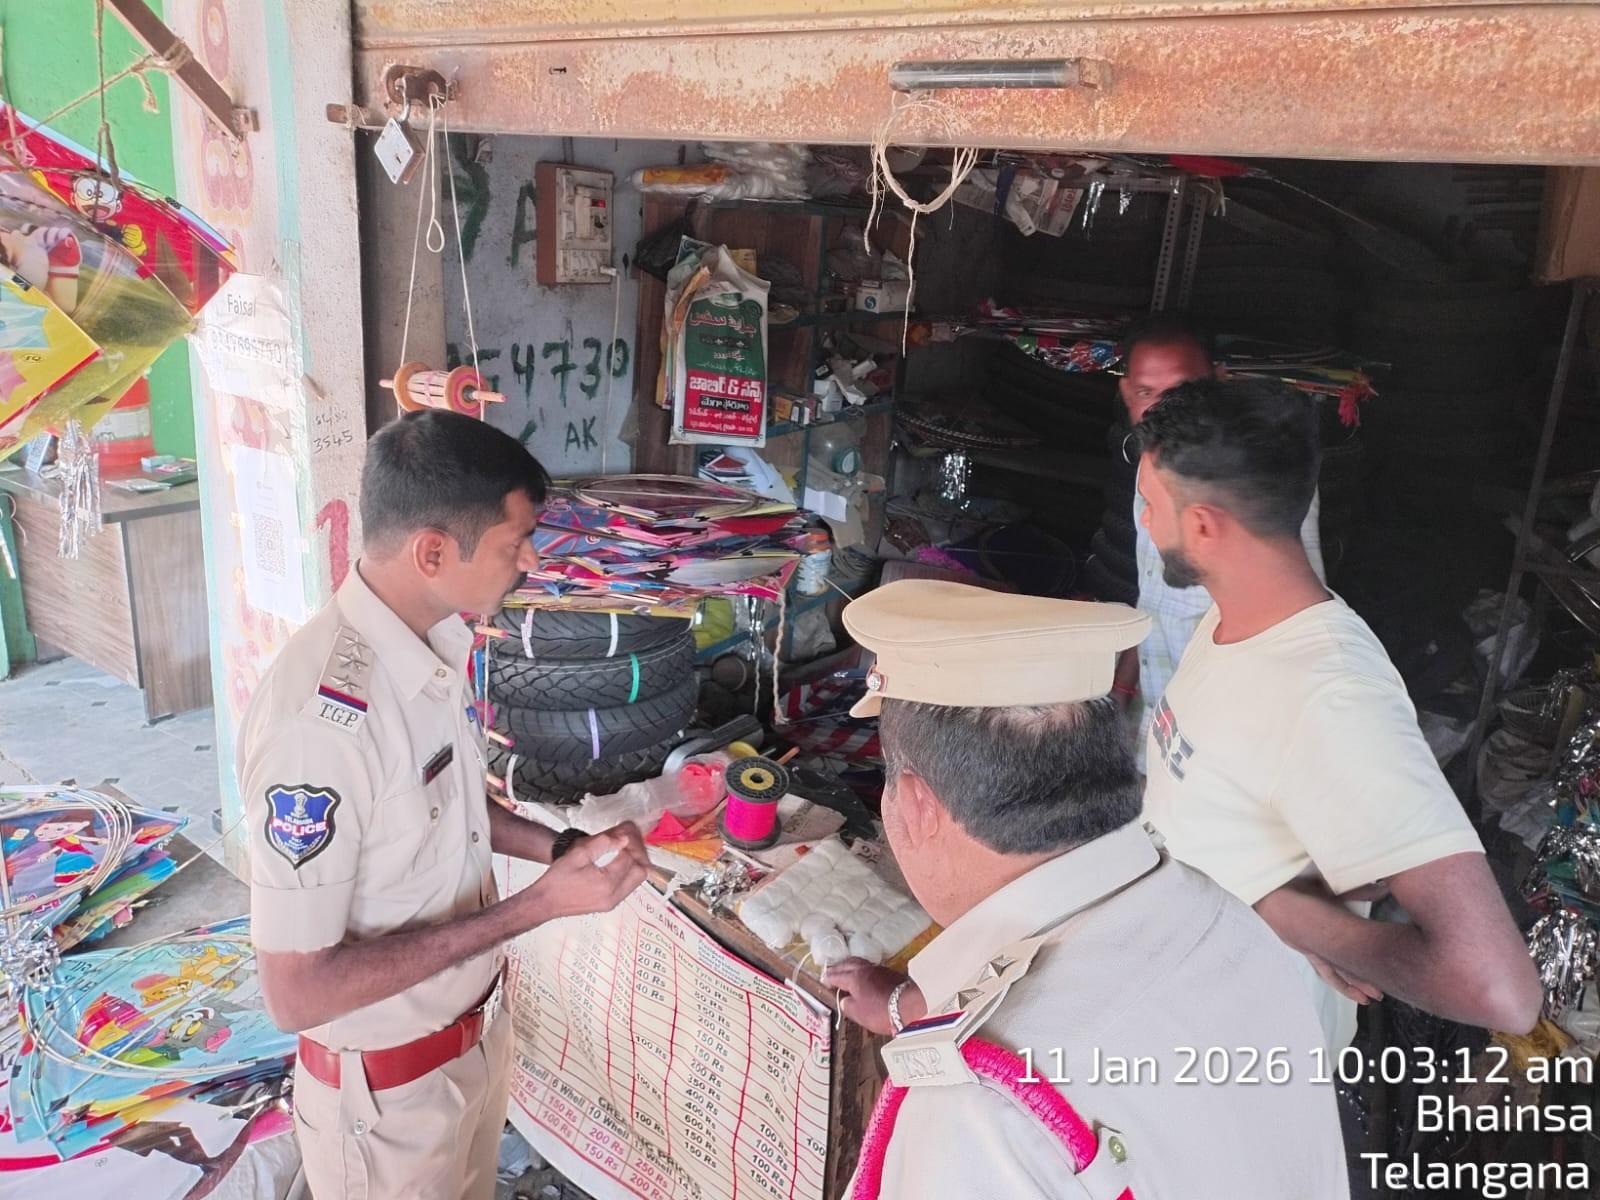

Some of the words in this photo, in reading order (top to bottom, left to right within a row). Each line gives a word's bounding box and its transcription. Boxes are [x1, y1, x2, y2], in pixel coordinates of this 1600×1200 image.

[227, 294, 256, 318] Faisal
[565, 416, 598, 452] AK
[272, 818, 327, 837] POLICE
[639, 941, 652, 952] 20
[654, 947, 667, 960] Rs
[638, 954, 650, 966] 20
[653, 962, 667, 974] Rs
[637, 968, 649, 980] 40
[652, 975, 666, 988] Rs
[636, 983, 648, 994] 40
[651, 990, 665, 1002] Rs
[695, 979, 711, 993] 100
[714, 991, 728, 1003] Rs
[697, 1004, 714, 1018] 150
[718, 1015, 730, 1028] Rs
[710, 1000, 724, 1012] Rs
[760, 1003, 773, 1015] Air
[698, 1015, 716, 1031] 200
[718, 1028, 730, 1041] Rs
[636, 1036, 653, 1050] 100
[655, 1047, 667, 1060] Rs
[696, 1030, 714, 1046] 150
[715, 1043, 729, 1057] Rs
[767, 1037, 779, 1050] 30
[782, 1049, 796, 1061] Rs
[522, 1056, 549, 1080] Whell
[694, 1045, 710, 1062] 150
[712, 1058, 725, 1072] Rs
[767, 1051, 780, 1064] 50
[690, 1059, 707, 1077] 200
[709, 1074, 722, 1087] Rs
[767, 1065, 780, 1078] 50
[525, 1080, 537, 1093] Rs
[552, 1079, 558, 1088] 6
[560, 1084, 586, 1107] Whell
[652, 1088, 662, 1100] Rs
[708, 1088, 721, 1101] Rs
[548, 1095, 565, 1112] 150
[565, 1109, 578, 1123] Rs
[686, 1089, 704, 1104] 400
[706, 1102, 719, 1116] Rs
[543, 1110, 559, 1127] 100
[560, 1124, 572, 1138] Rs
[588, 1106, 601, 1119] 10
[603, 1116, 630, 1140] Whell
[635, 1111, 652, 1126] 100
[654, 1123, 665, 1136] Rs
[685, 1102, 703, 1117] 400
[705, 1116, 716, 1129] Rs
[685, 1114, 703, 1130] 600
[705, 1129, 716, 1142] Rs
[589, 1127, 610, 1145] 200
[611, 1141, 624, 1155] Rs
[685, 1129, 703, 1144] 150
[705, 1142, 717, 1155] Rs
[760, 1124, 777, 1142] 100
[778, 1142, 788, 1156] Rs
[806, 1137, 826, 1156] 100
[586, 1143, 604, 1160] 150
[604, 1156, 618, 1170] Rs
[646, 1151, 673, 1176] Whell
[685, 1142, 702, 1158] 150
[704, 1155, 717, 1169] Rs
[755, 1139, 774, 1158] 100
[776, 1155, 788, 1171] Rs
[630, 1174, 649, 1191] 200
[635, 1158, 654, 1176] 250
[656, 1173, 668, 1188] Rs
[750, 1169, 768, 1188] 150
[753, 1155, 770, 1173] 100
[772, 1172, 785, 1187] Rs
